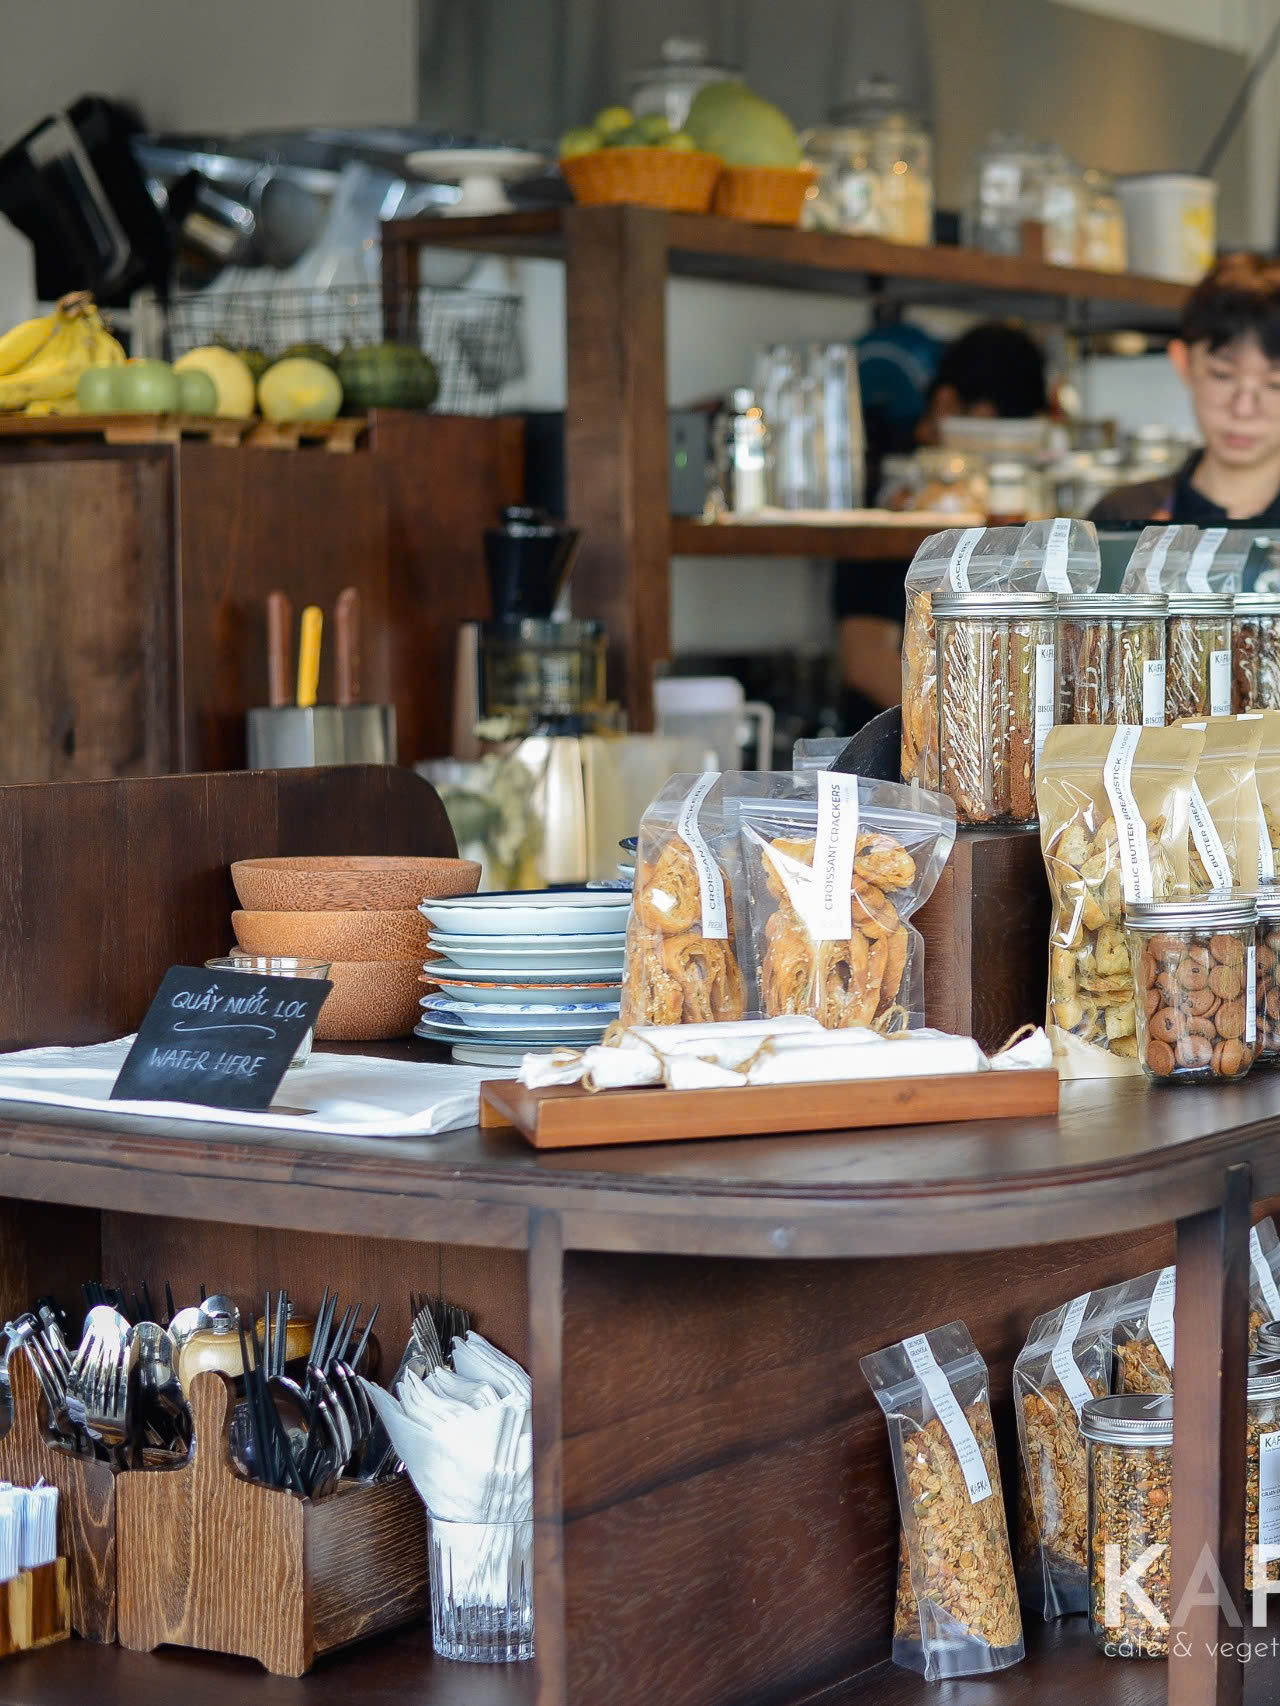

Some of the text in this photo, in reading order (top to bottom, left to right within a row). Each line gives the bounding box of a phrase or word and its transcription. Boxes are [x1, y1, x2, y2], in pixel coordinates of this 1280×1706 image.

[953, 539, 972, 592] RACKERS
[1112, 757, 1132, 821] BREADSTICK
[823, 783, 842, 911] CROISSANT CRACKERS
[1126, 822, 1139, 864] BUTTER
[1201, 830, 1219, 868] BUTTER
[273, 1000, 309, 1023] LỌC
[149, 1046, 267, 1077] WATER HERE
